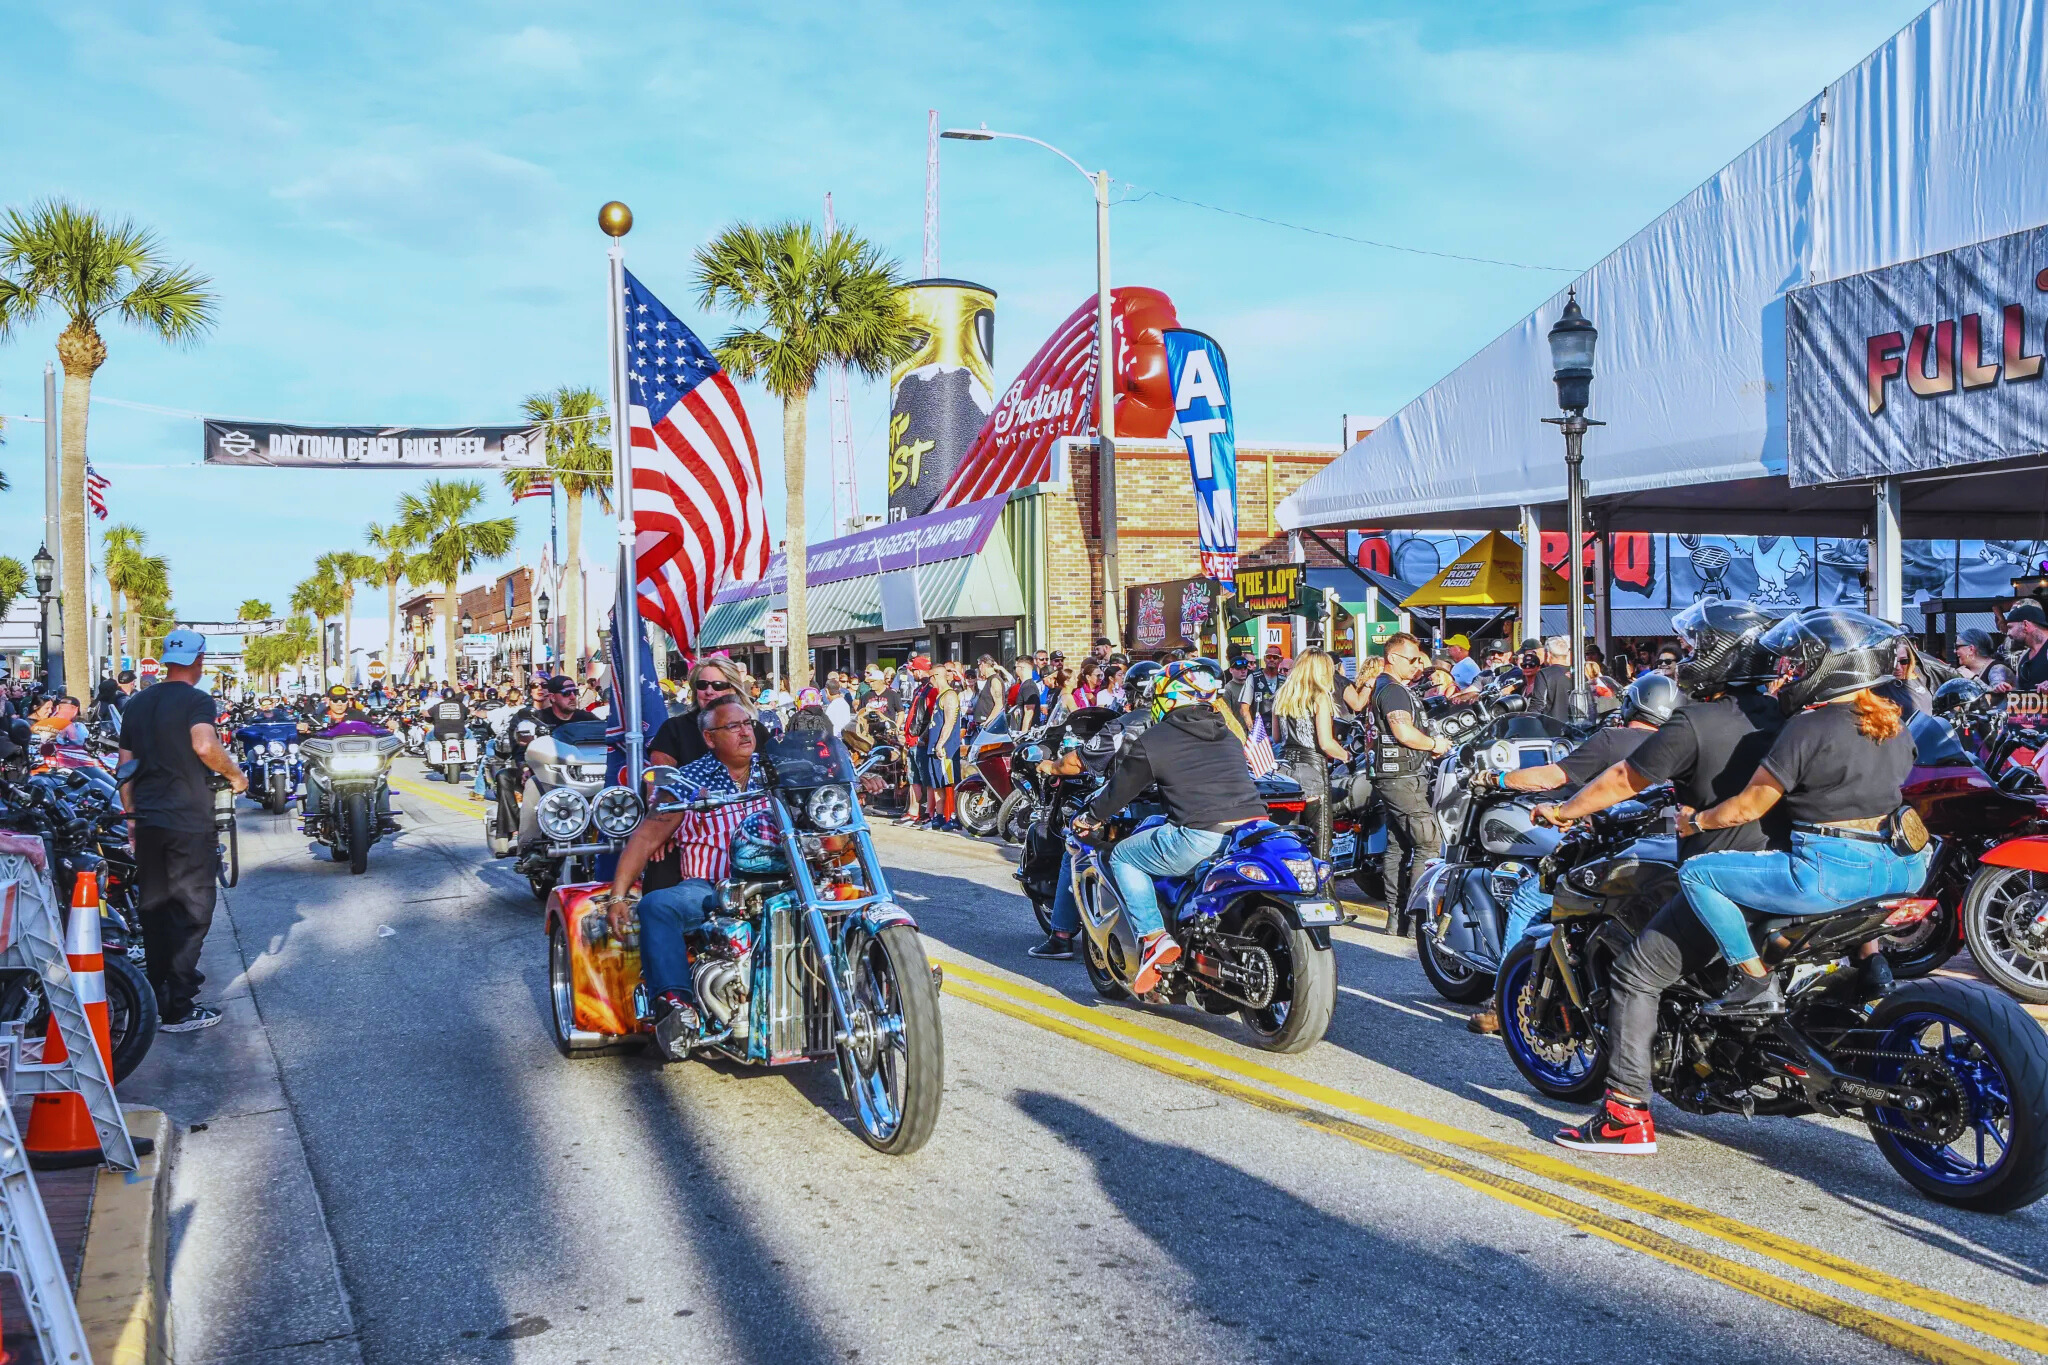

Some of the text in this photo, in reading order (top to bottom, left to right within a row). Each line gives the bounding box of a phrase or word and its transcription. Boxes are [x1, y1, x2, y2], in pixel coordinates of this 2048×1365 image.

[1867, 303, 2045, 417] FULL
[269, 434, 486, 461] DAYTONA BEACH BIKE WEEK
[995, 420, 1069, 448] MOTORCYCLE
[1175, 349, 1236, 548] ATM
[813, 549, 842, 572] KING
[835, 545, 857, 568] OF
[849, 541, 875, 564] THE
[867, 529, 921, 560] BAGGERS
[916, 514, 980, 549] CHAMPION
[1202, 553, 1238, 580] HERE
[1236, 568, 1297, 603] THE LOT
[1440, 578, 1474, 586] INSIDE
[1250, 599, 1266, 611] FULL
[1266, 596, 1287, 609] MOON
[368, 666, 385, 674] STOP
[1840, 1081, 1885, 1100] MT-09
